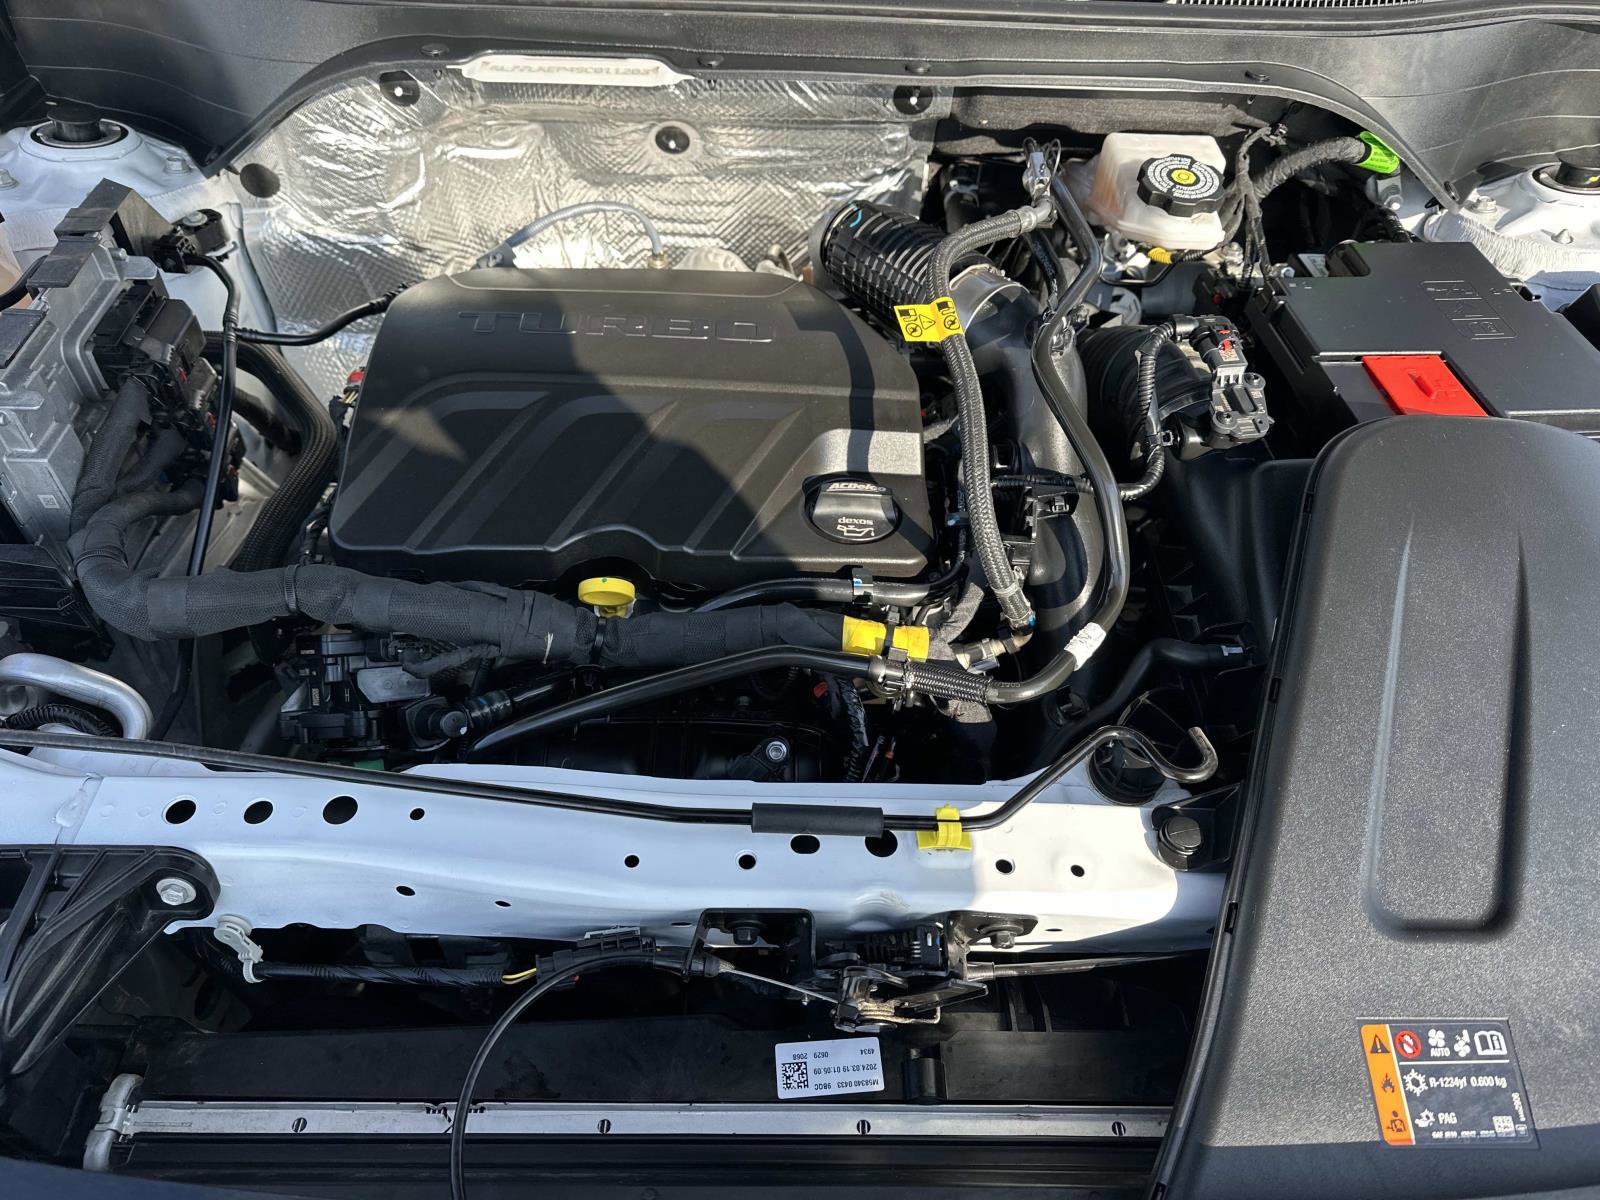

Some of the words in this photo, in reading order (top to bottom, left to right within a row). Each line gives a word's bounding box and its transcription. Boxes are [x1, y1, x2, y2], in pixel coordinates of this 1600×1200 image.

[458, 311, 776, 343] TURBO
[838, 517, 874, 525] dexos
[1430, 1048, 1450, 1057] AUTO
[836, 1080, 853, 1089] 0433
[1495, 1075, 1508, 1088] kg
[1438, 1111, 1458, 1125] PAG
